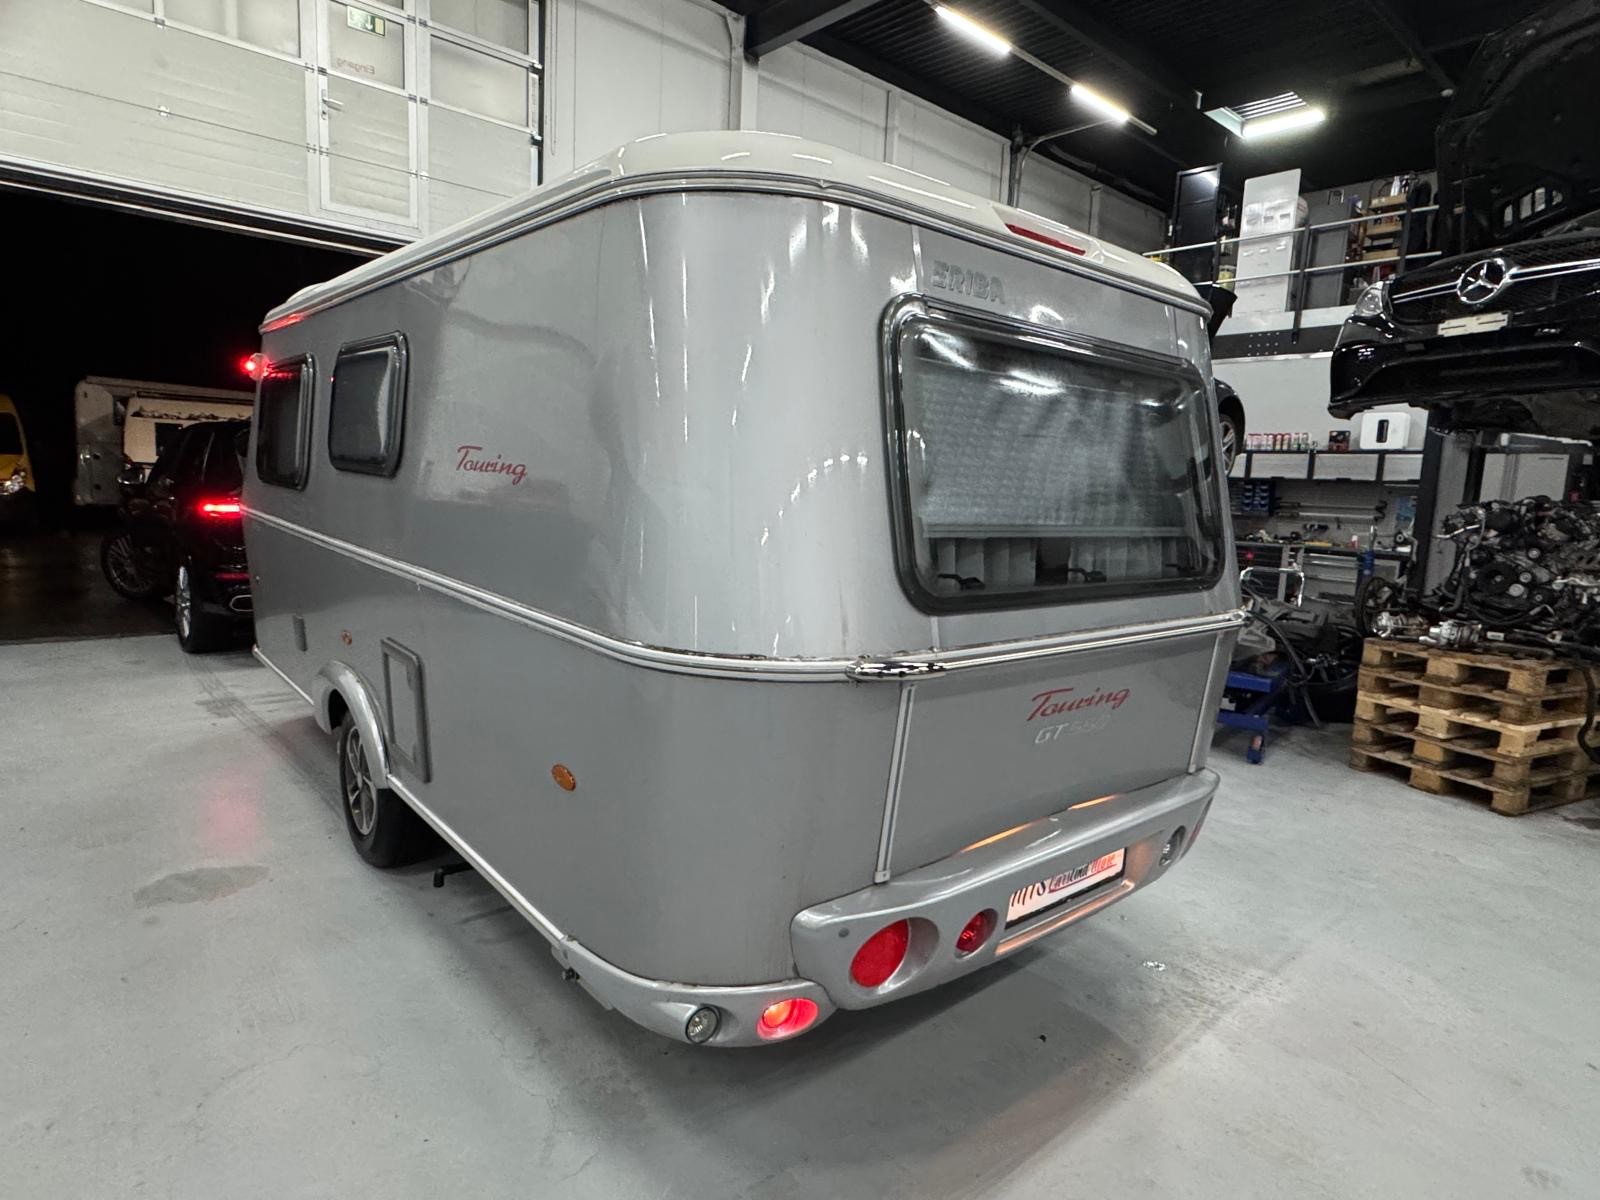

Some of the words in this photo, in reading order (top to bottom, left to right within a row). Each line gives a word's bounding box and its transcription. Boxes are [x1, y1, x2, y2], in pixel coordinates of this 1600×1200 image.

[931, 260, 1005, 305] ERIBA
[456, 445, 527, 486] Touring
[1027, 687, 1130, 722] Touring
